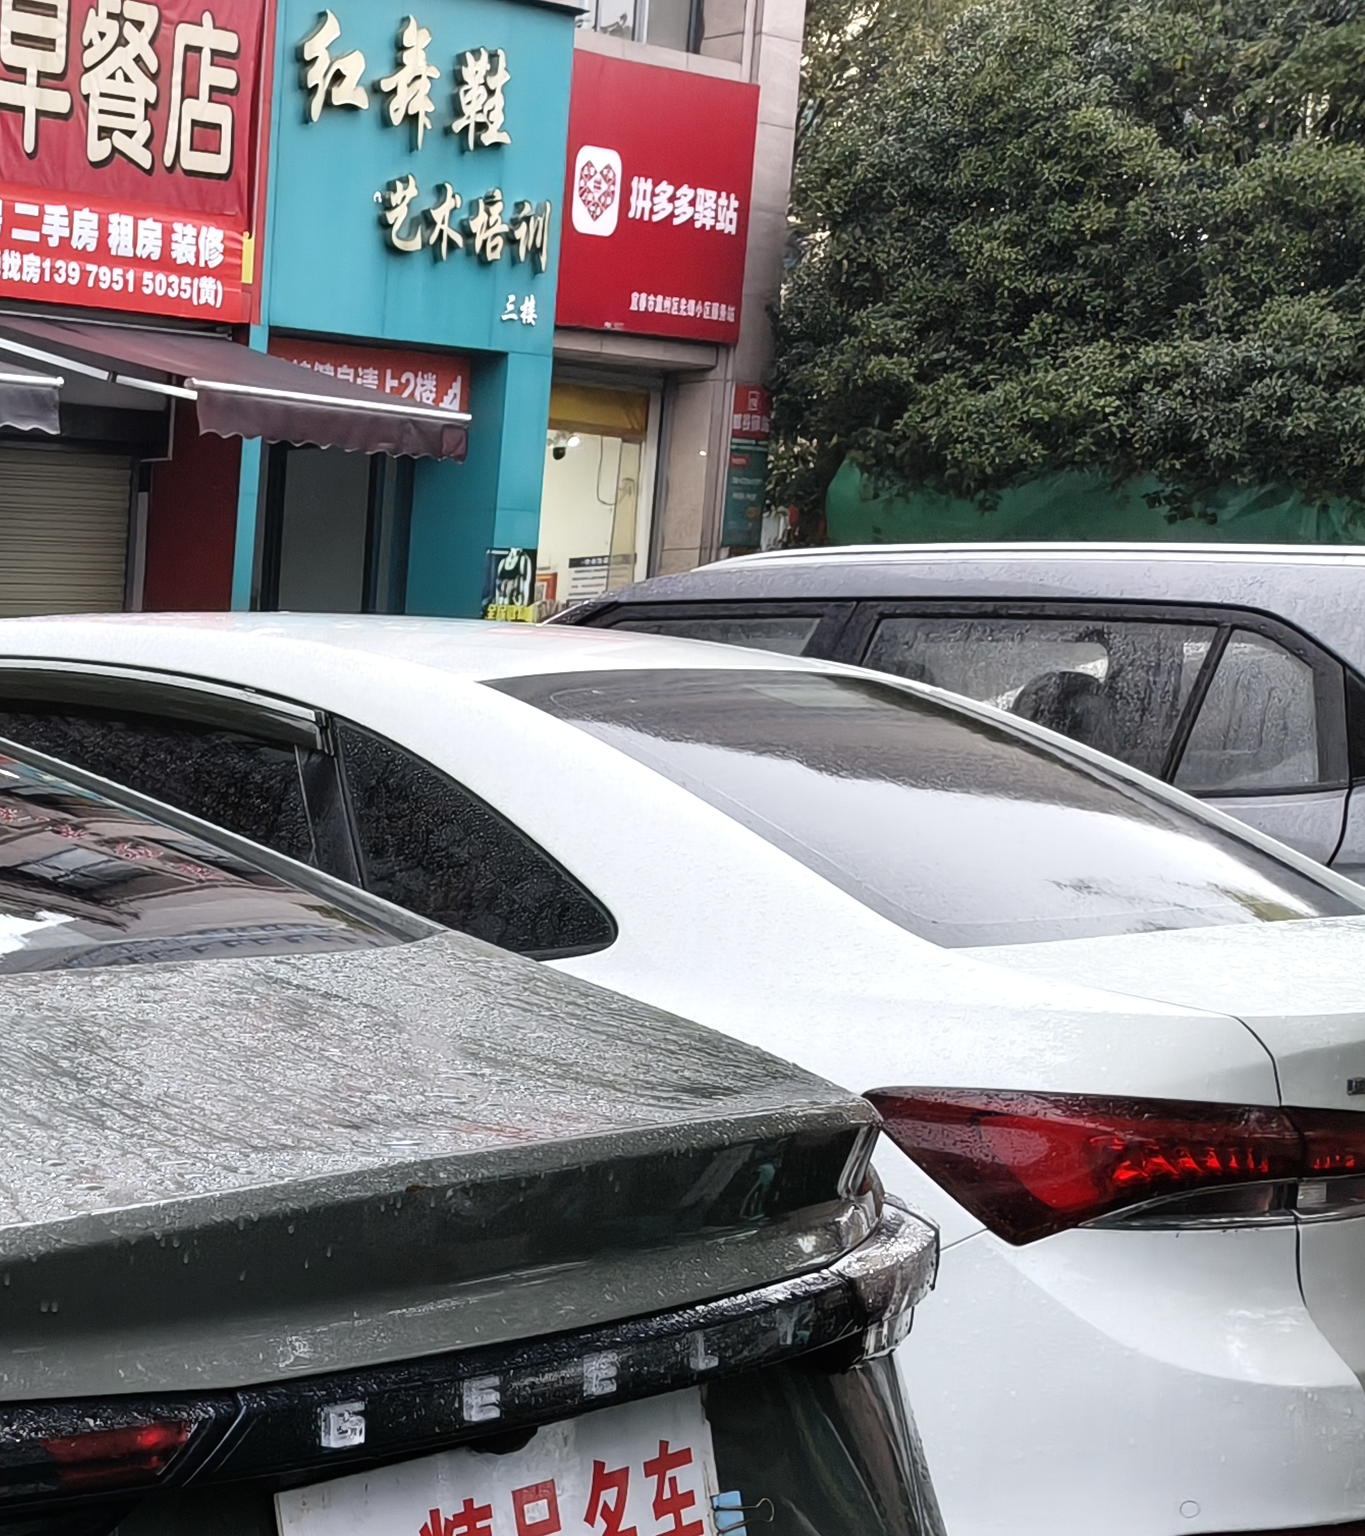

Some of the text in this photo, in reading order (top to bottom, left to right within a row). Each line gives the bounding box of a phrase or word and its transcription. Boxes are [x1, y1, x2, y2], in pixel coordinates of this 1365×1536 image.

[11, 203, 99, 252] 二手房
[107, 212, 163, 261] 租房
[171, 222, 225, 269] 装修
[384, 173, 553, 279] 艺术培训
[628, 176, 739, 236] 拼多多驿站
[501, 294, 539, 328] 三楼
